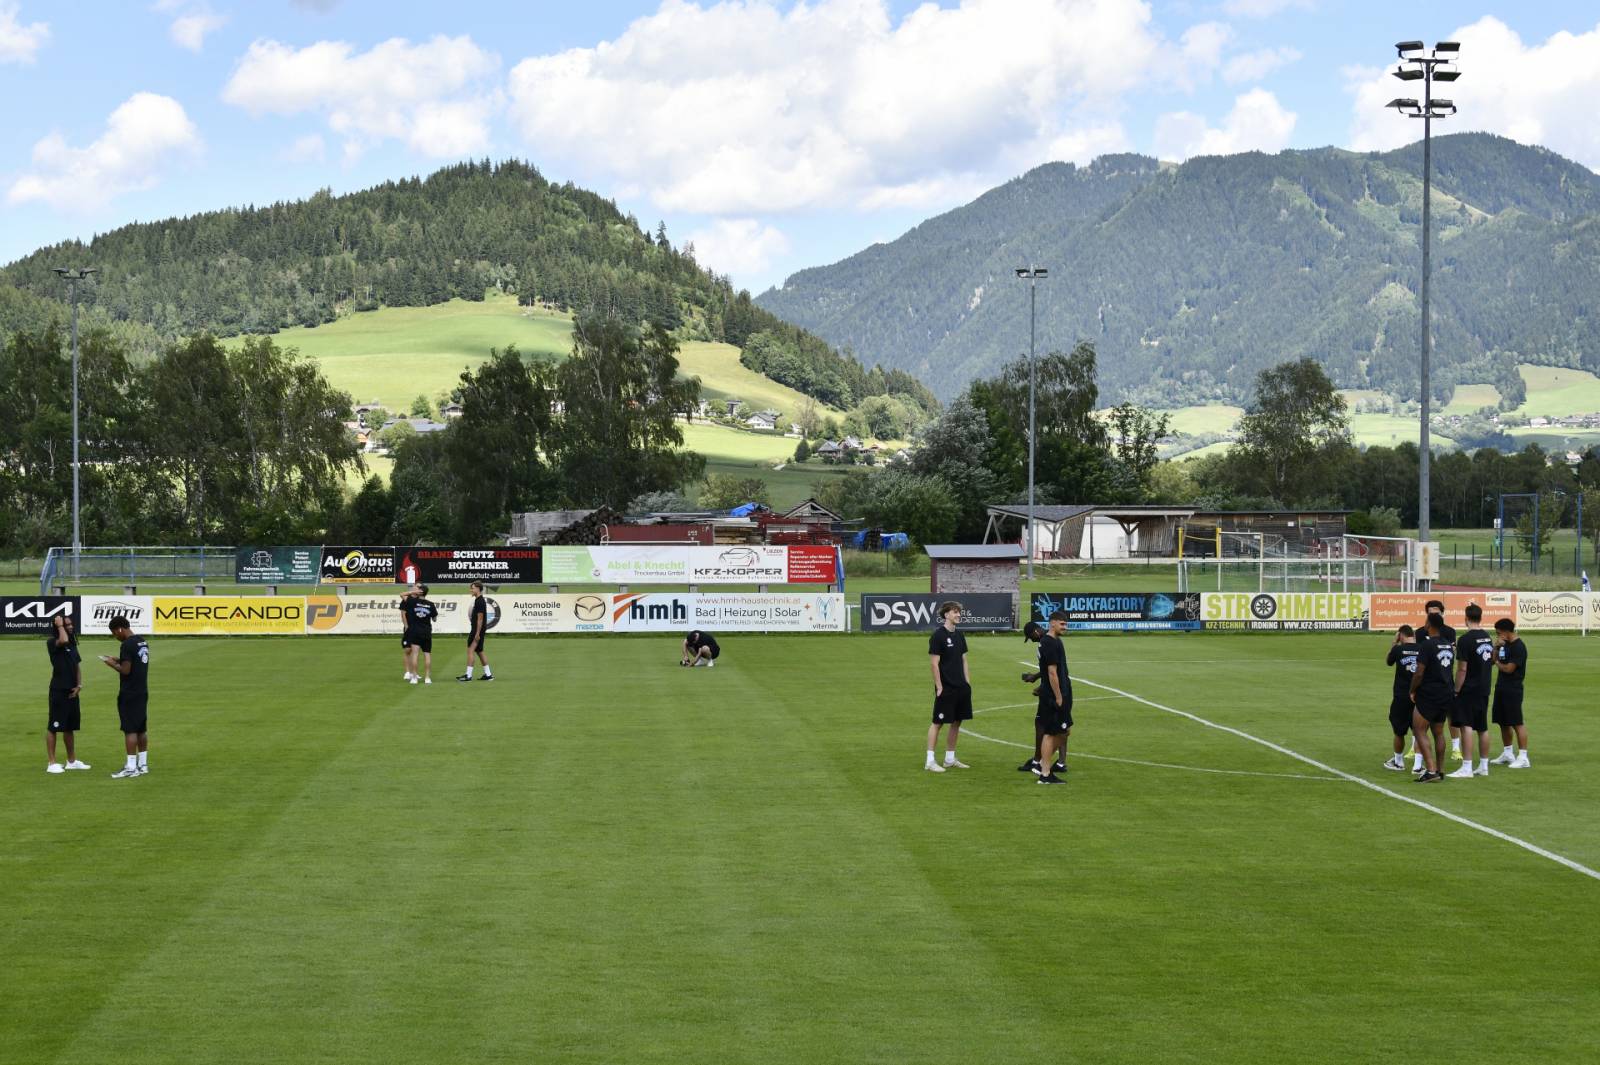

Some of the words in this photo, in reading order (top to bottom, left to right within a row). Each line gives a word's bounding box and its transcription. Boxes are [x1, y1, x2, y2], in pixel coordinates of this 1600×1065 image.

[324, 552, 392, 572] Autohaus
[448, 560, 509, 570] HÖFLEHNER
[608, 560, 631, 570] Abel
[634, 561, 641, 569] &
[644, 560, 685, 570] Knechtl
[346, 600, 457, 612] petutnig
[696, 596, 800, 604] www.hmh-haustechnik.at
[1064, 597, 1145, 611] LACKFACTORY
[1207, 594, 1363, 619] STROHMEIER
[5, 601, 73, 618] KIA
[156, 606, 300, 619] MERCANDO
[632, 599, 686, 619] hmh
[696, 608, 716, 617] Bad
[724, 608, 766, 619] Heizung
[775, 608, 801, 617] Solar
[871, 601, 936, 625] DSW
[1520, 604, 1583, 615] WebHosting
